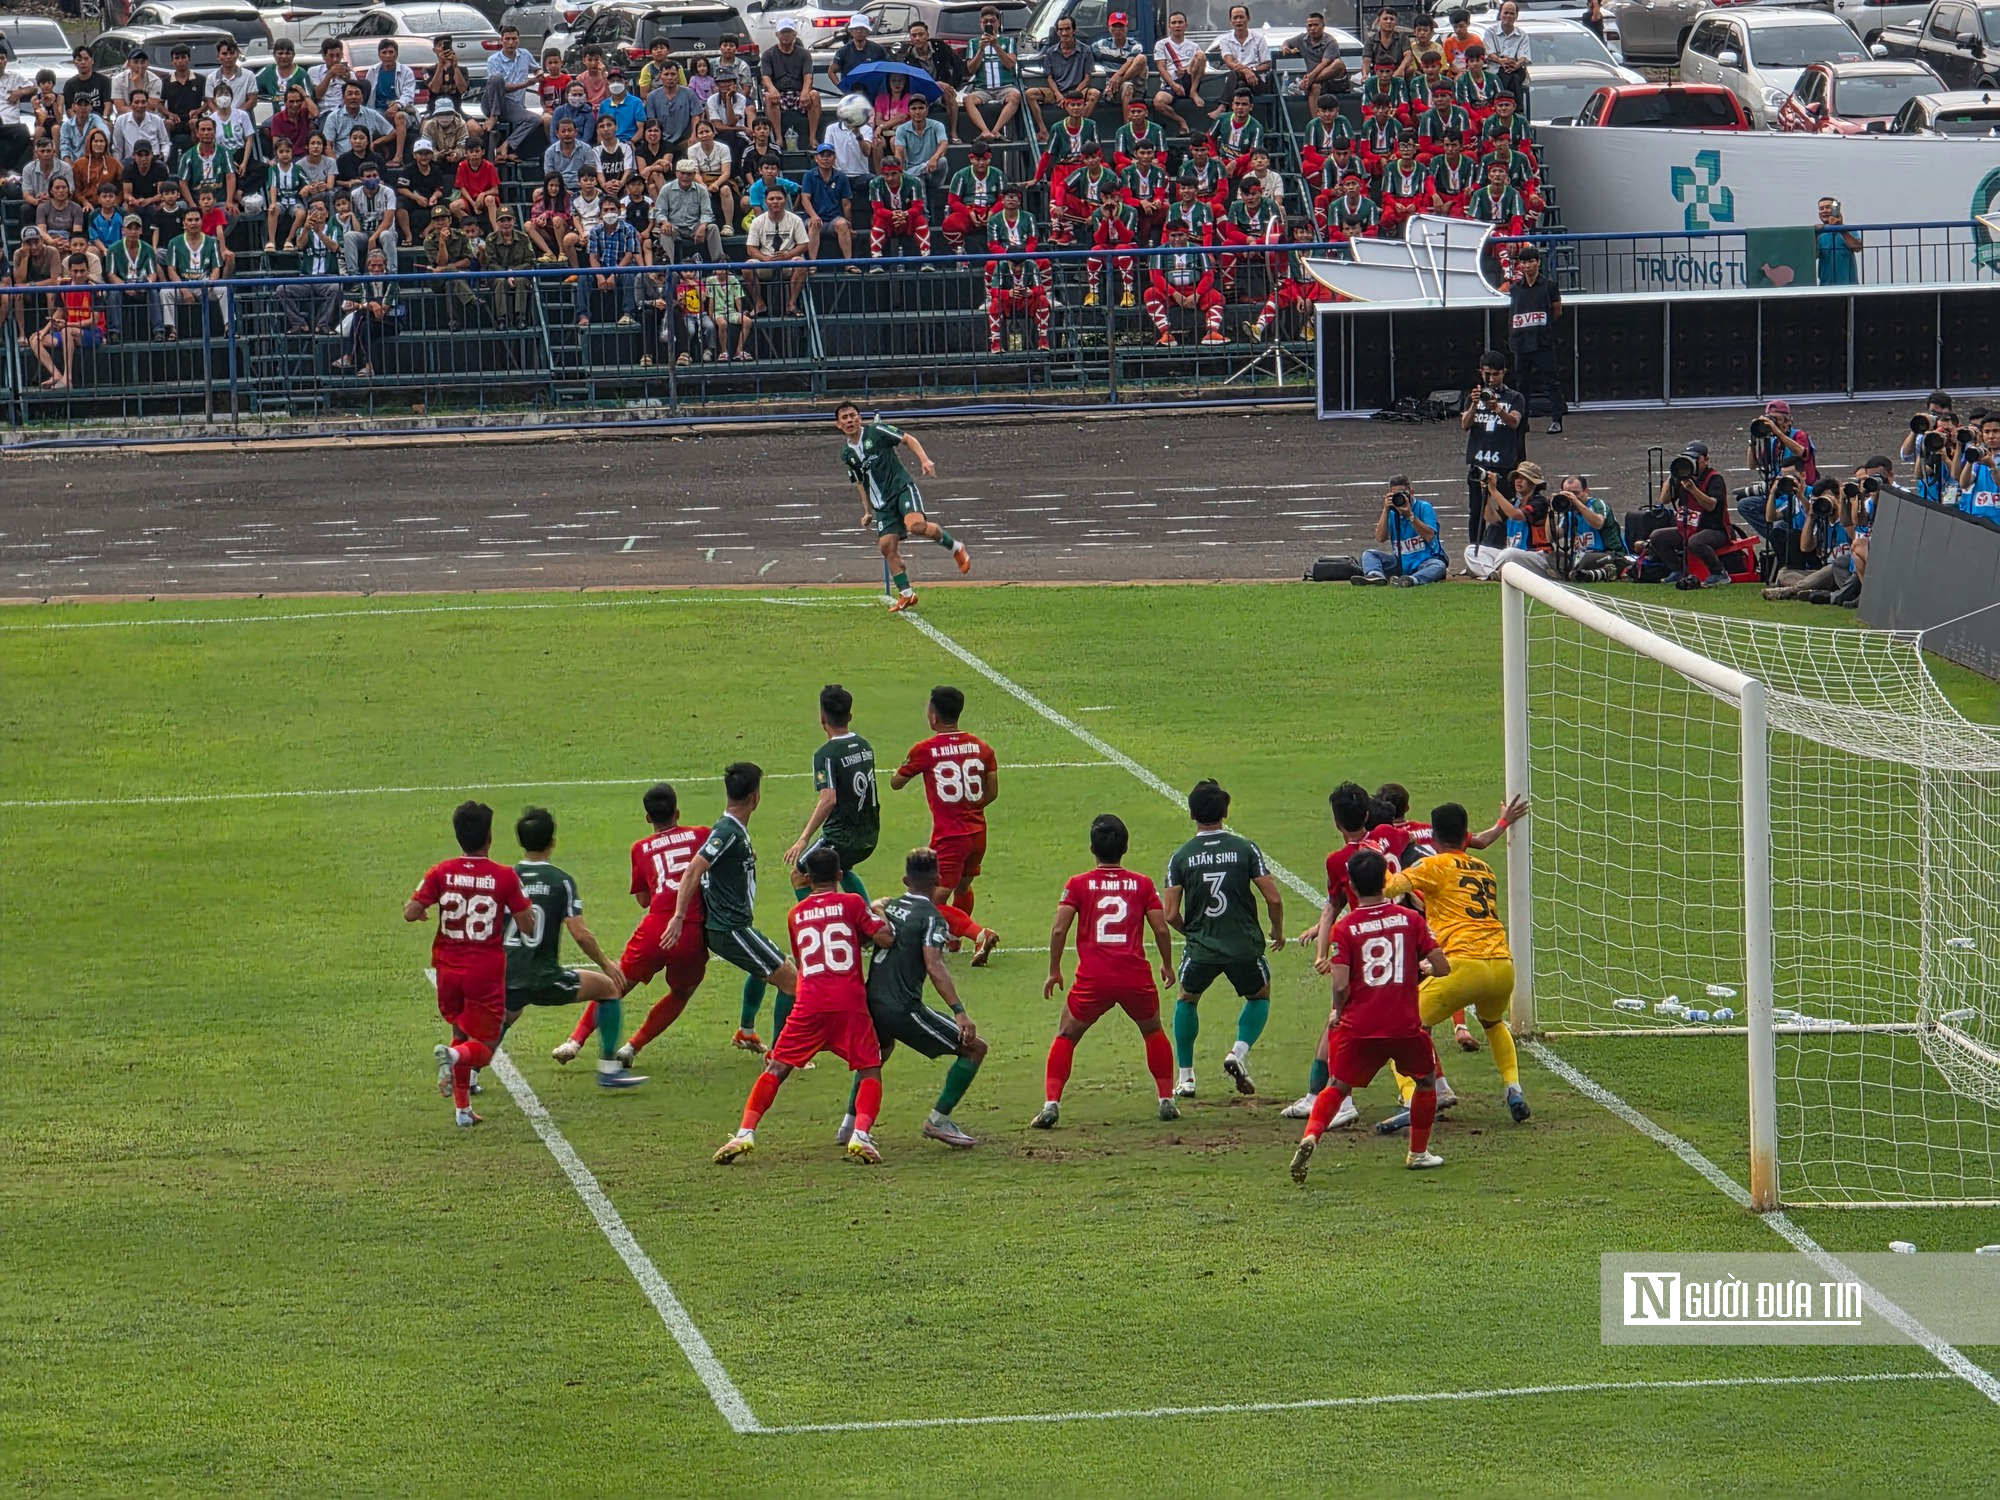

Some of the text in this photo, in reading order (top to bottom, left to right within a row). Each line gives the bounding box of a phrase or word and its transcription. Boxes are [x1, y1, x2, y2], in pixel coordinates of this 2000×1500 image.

[1475, 450, 1500, 463] 446
[853, 768, 877, 812] 91
[933, 758, 985, 803] 86
[653, 847, 691, 894] 15
[1216, 852, 1238, 864] SINH
[1088, 878, 1138, 891] N. ANH TÀI
[1203, 871, 1228, 918] 3
[440, 892, 498, 941] 28
[1097, 896, 1128, 943] 2
[797, 922, 854, 978] 26
[1362, 933, 1404, 986] 81
